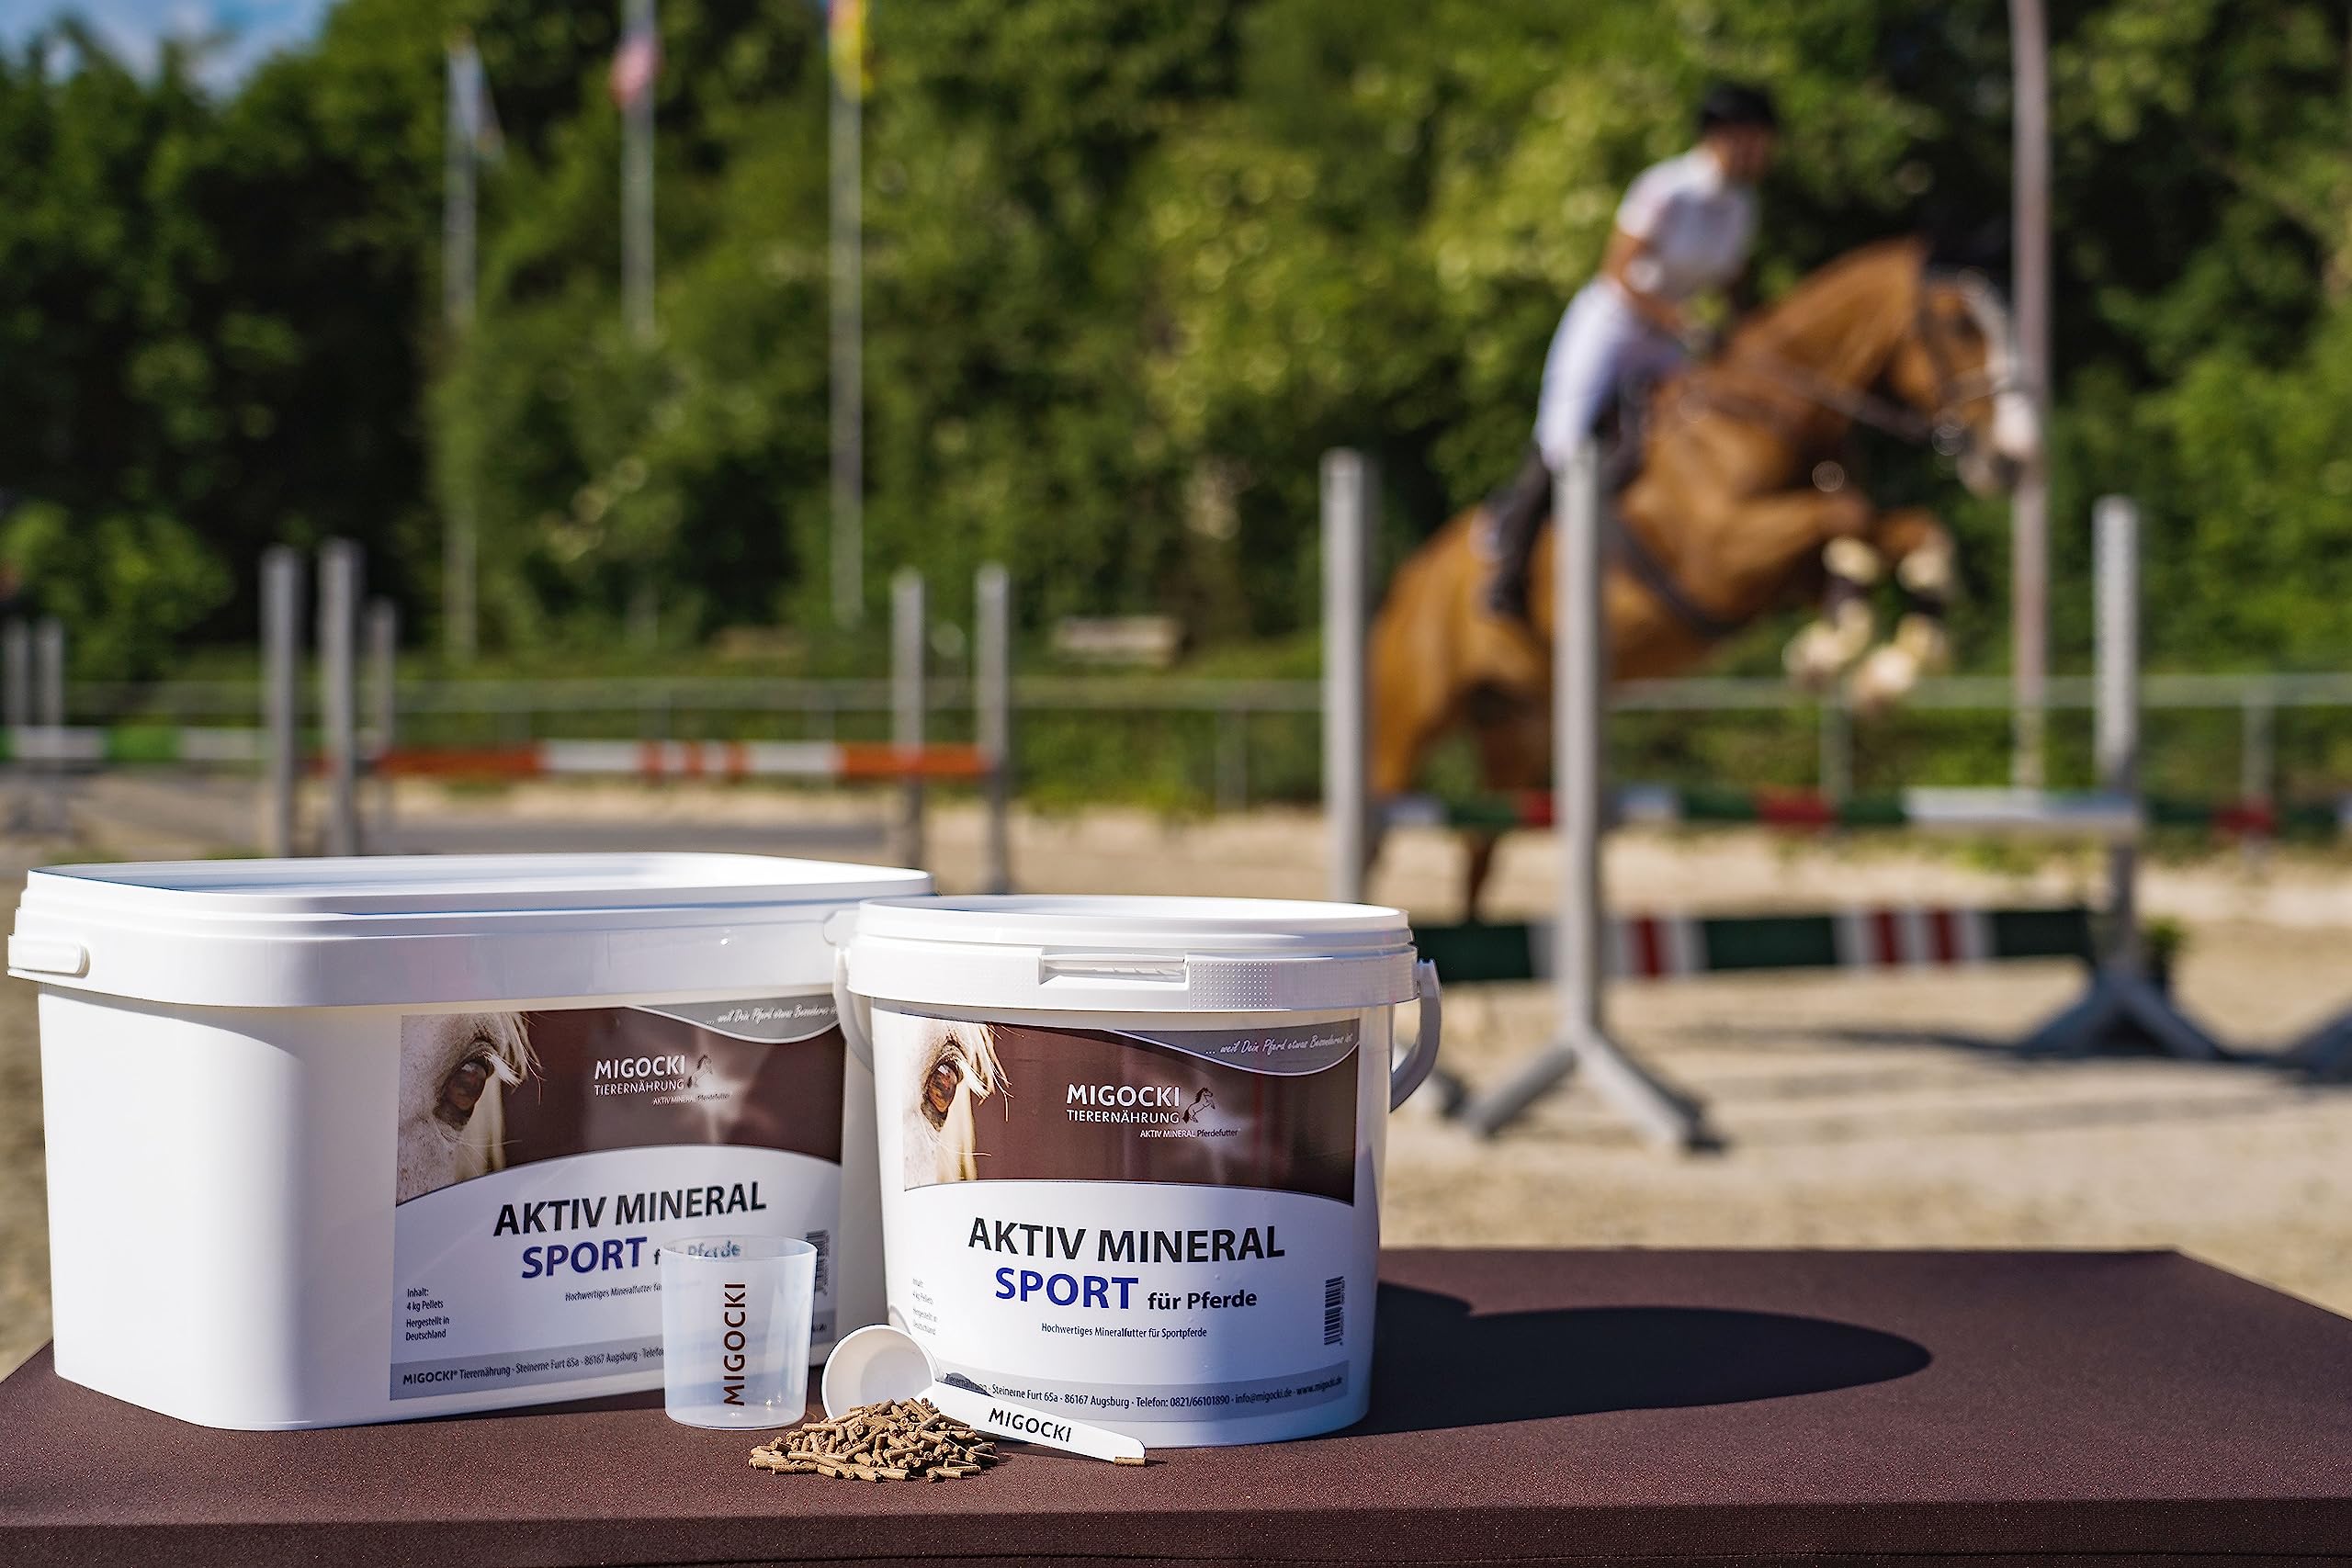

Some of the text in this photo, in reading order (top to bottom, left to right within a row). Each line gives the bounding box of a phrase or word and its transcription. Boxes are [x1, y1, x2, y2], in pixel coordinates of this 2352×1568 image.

[1262, 1038, 1285, 1055] Pferd
[594, 1055, 685, 1080] MIGOCKI
[594, 1078, 684, 1096] TIERERNÄHRUNG
[1067, 1084, 1180, 1107] MIGOCKI
[1066, 1109, 1180, 1123] TIERERNÄHRUNG
[1140, 1130, 1162, 1138] AKTIV
[1163, 1130, 1195, 1138] MINERAL
[493, 1181, 767, 1236] AKTIV MINERAL
[968, 1217, 1285, 1263] AKTIV MINERAL
[522, 1237, 647, 1279] SPORT
[407, 1288, 429, 1298] Inhalt:
[565, 1288, 609, 1302] Hochwertiges
[611, 1283, 652, 1297] Mineralfutter
[995, 1268, 1258, 1311] SPORT für Pferde
[407, 1299, 444, 1312] 4 kg Pellets
[406, 1315, 450, 1329] Hergestellt in
[1041, 1323, 1207, 1340] Hochwertiges Mineralfutter für Sportpferde
[405, 1329, 447, 1341] Deutschland
[723, 1283, 746, 1406] MIGOCKI
[458, 1366, 511, 1380] Tierernährung
[605, 1350, 639, 1365] Augsburg
[992, 1384, 1026, 1399] Steinerne
[1027, 1389, 1043, 1402] Furt
[1044, 1392, 1058, 1403] 65a
[1064, 1393, 1089, 1405] 86167
[1090, 1396, 1130, 1410] Augsburg
[1136, 1396, 1169, 1408] Telefon:
[1170, 1394, 1230, 1408] 0821/66101890
[989, 1407, 1072, 1443] MIGOCKI
